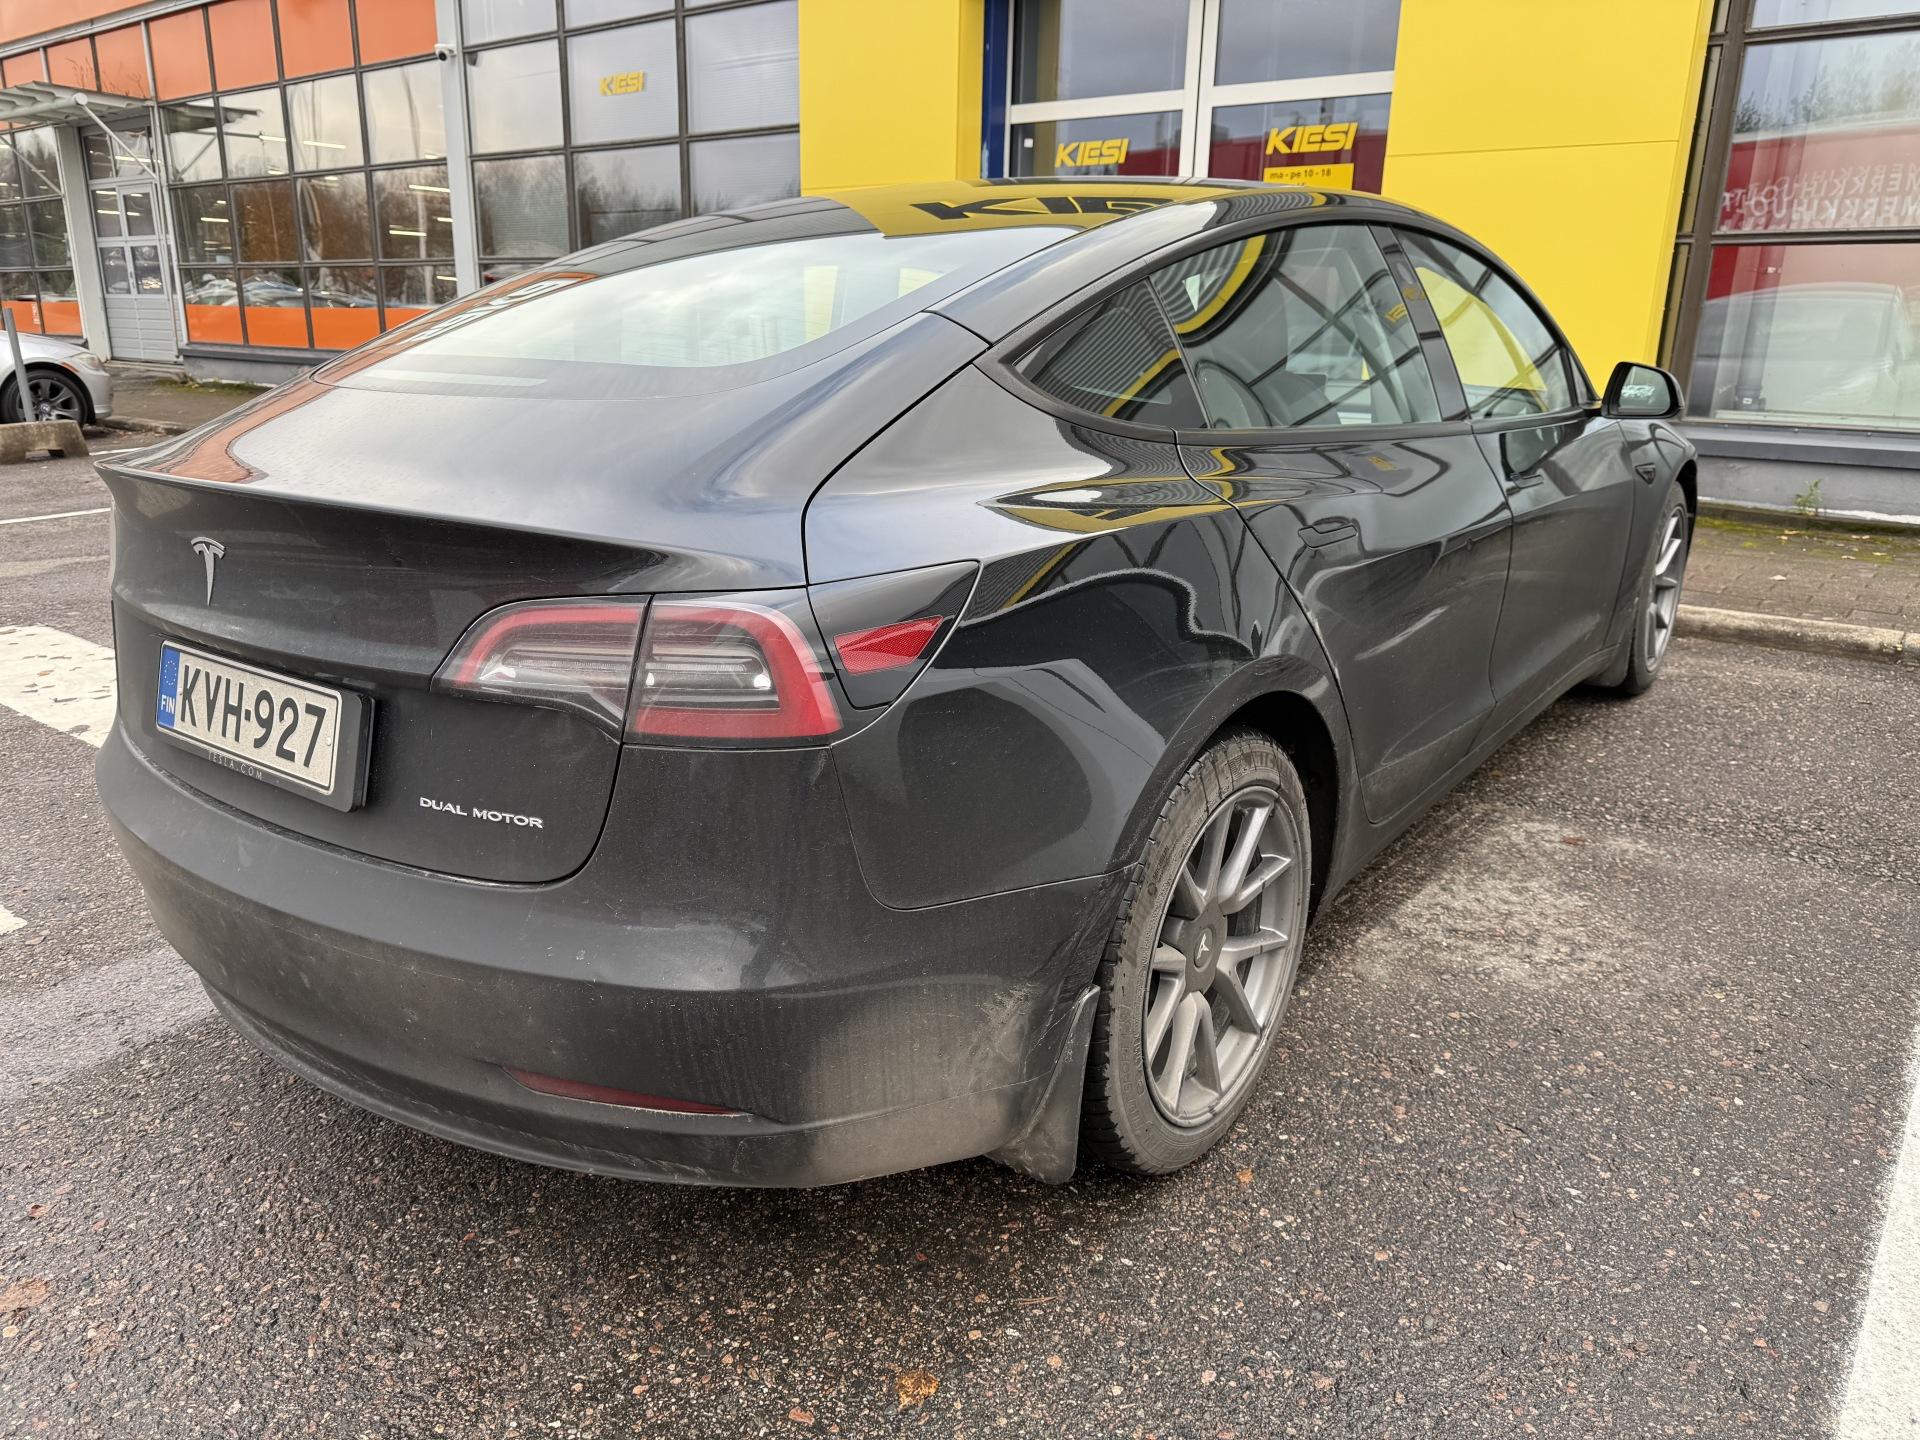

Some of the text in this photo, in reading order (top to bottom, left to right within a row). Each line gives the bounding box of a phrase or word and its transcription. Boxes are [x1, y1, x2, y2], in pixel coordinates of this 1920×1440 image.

[600, 71, 645, 96] KIESI
[1055, 138, 1129, 168] KIESI
[1265, 122, 1358, 155] KIESI
[161, 694, 175, 715] FIN
[180, 664, 327, 768] KVH-927
[208, 750, 263, 781] TESLA.COM
[419, 796, 544, 829] DUAL MOTOR
